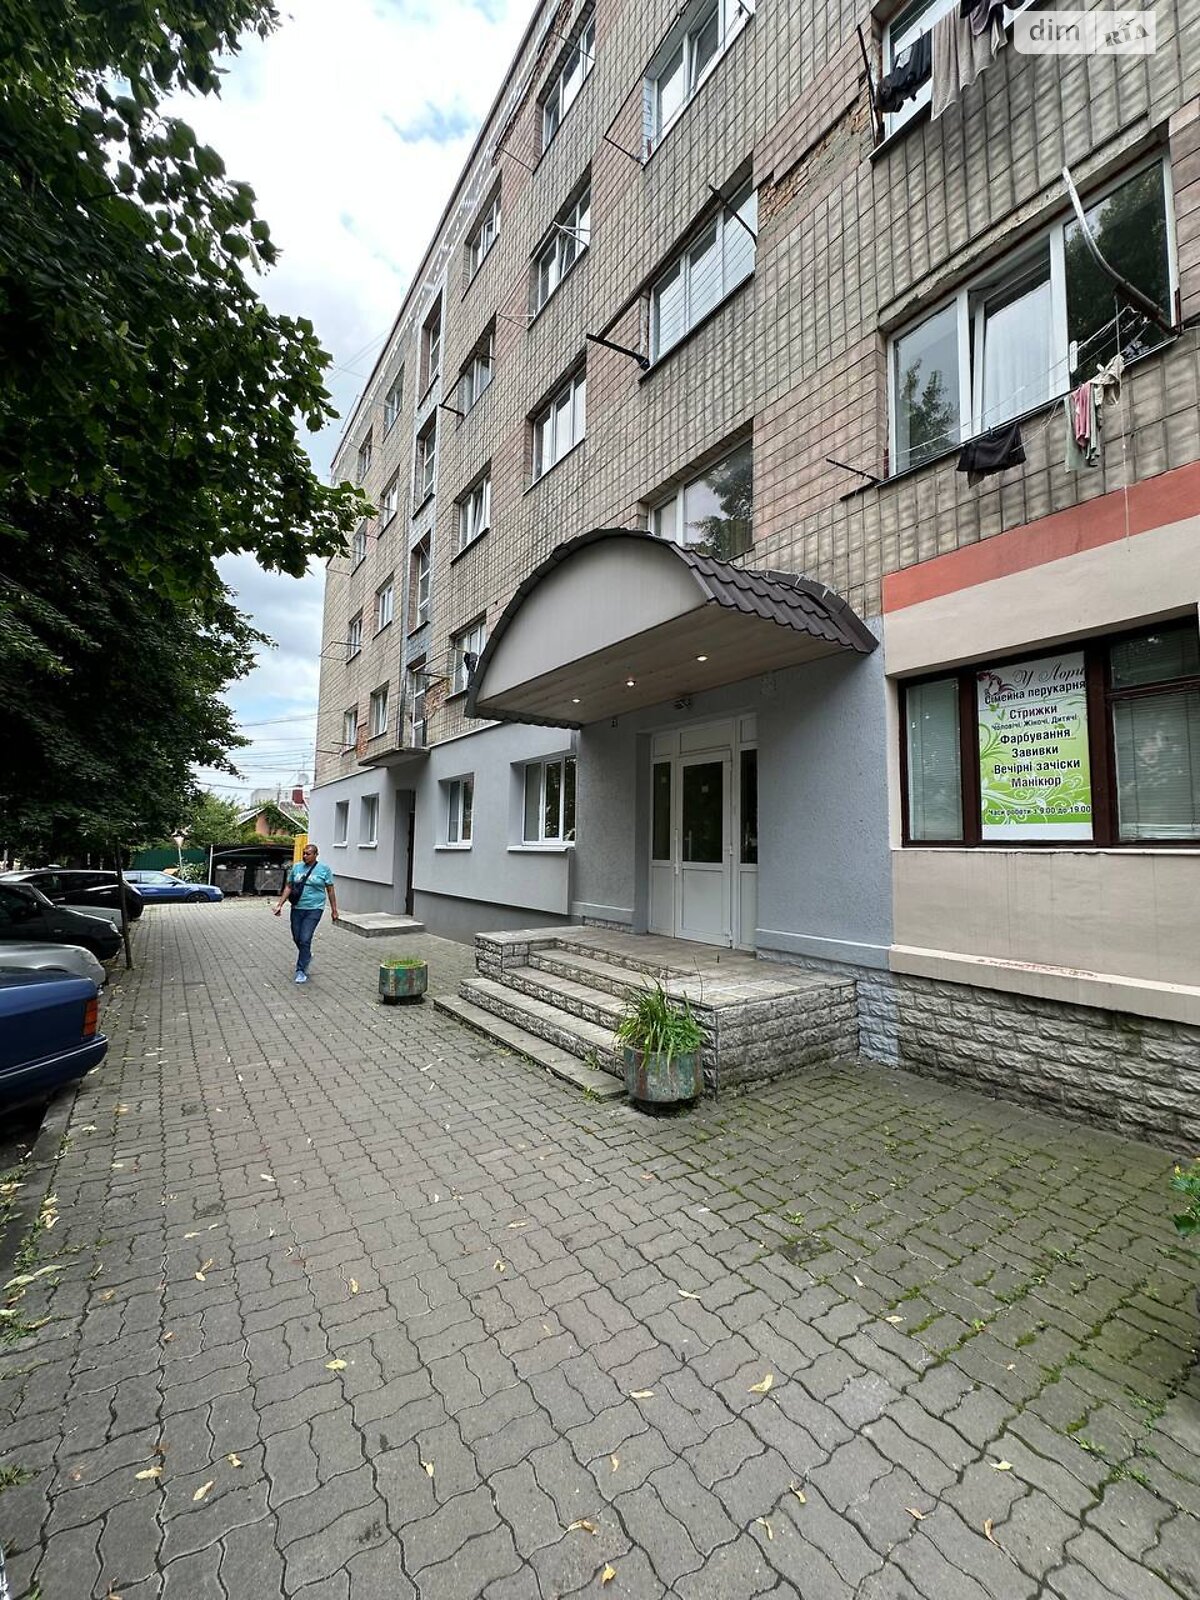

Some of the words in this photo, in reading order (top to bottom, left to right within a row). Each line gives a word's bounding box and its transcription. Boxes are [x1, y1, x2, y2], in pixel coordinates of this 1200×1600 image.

[1028, 680, 1087, 698] перукарня
[1009, 705, 1058, 720] Стрижки
[1000, 729, 1071, 745] Фарбування
[1011, 746, 1059, 758] Завивки
[994, 761, 1032, 775] Вечірні
[1036, 758, 1081, 771] зачіски
[1011, 776, 1061, 788] Манікюр
